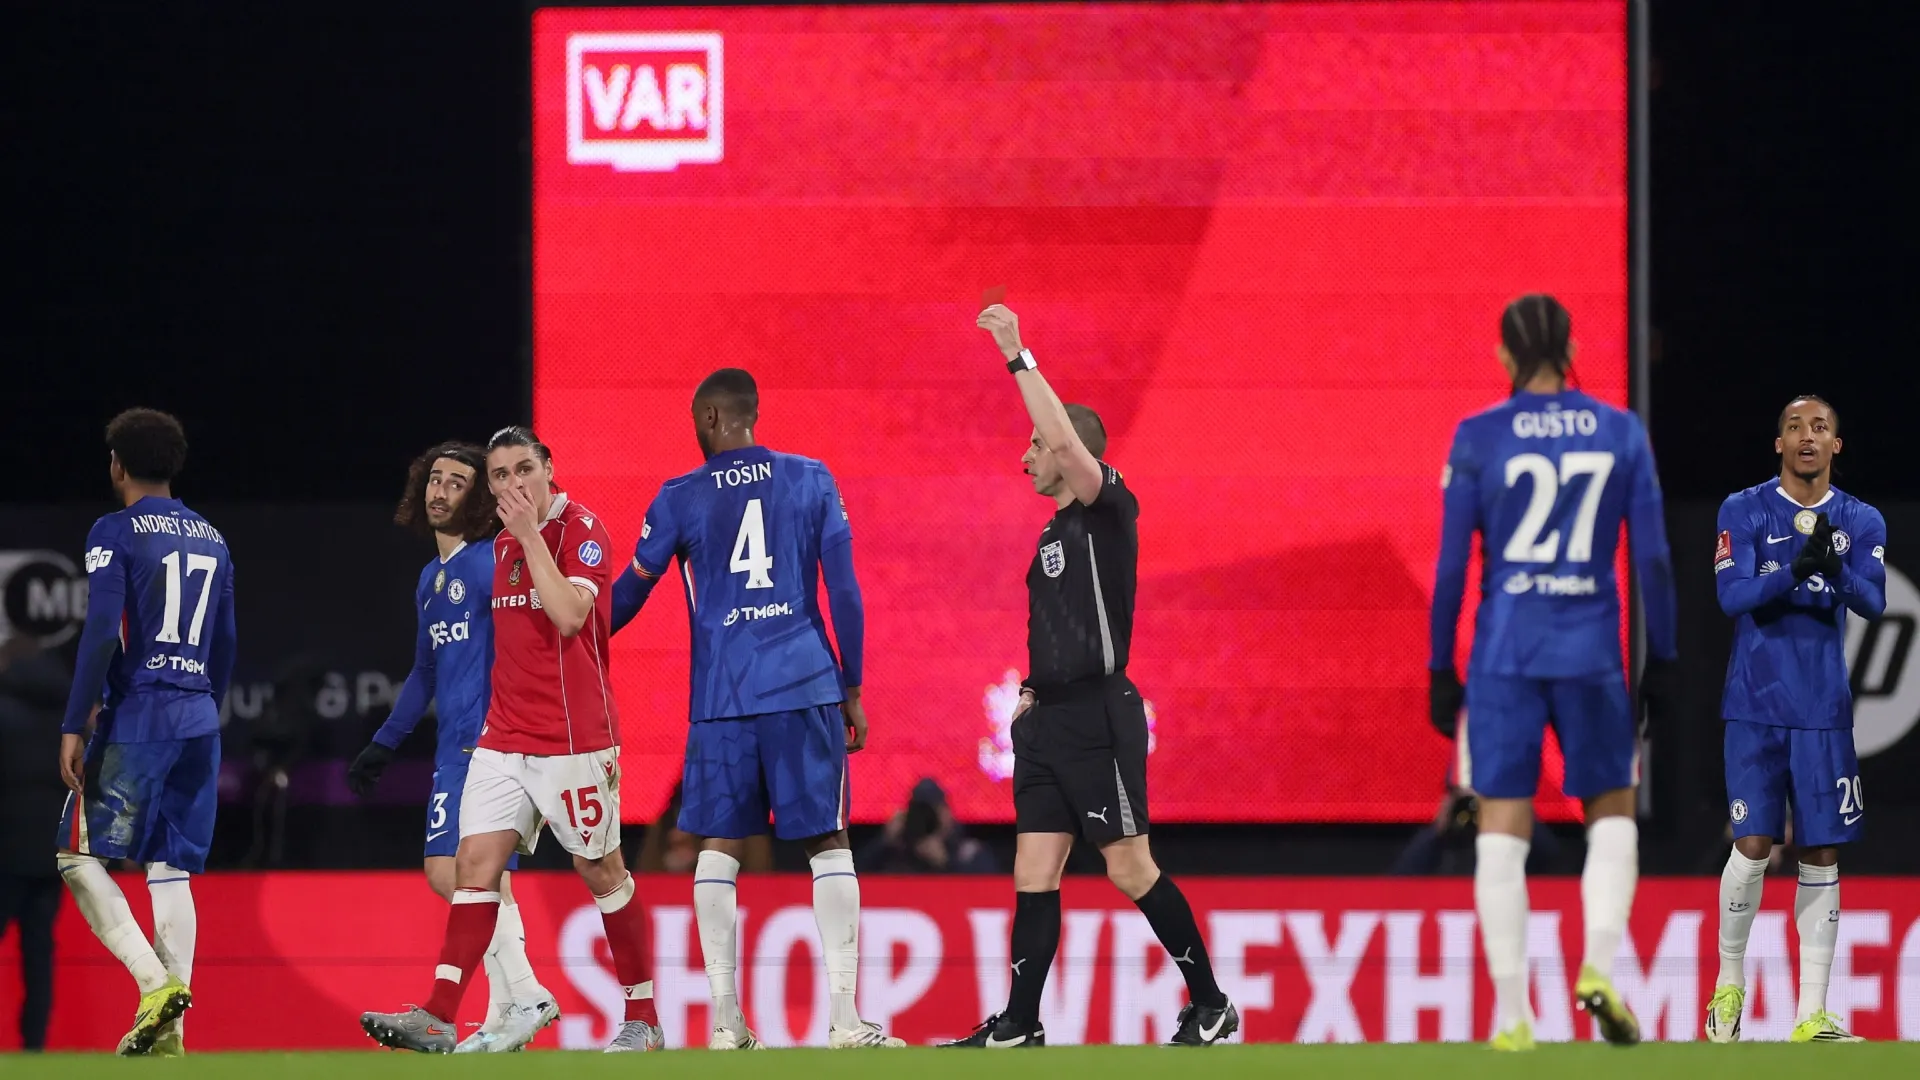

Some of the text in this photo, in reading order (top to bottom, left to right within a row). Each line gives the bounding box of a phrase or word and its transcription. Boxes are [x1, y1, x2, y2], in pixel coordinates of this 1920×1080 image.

[583, 64, 708, 131] VAR
[1512, 409, 1598, 438] GUSTO
[711, 462, 772, 489] TOSIN
[1503, 451, 1615, 563] 27
[131, 514, 224, 545] ANDREY SANTOS
[729, 498, 774, 589] 4
[580, 541, 601, 565] hp
[155, 551, 218, 647] 17
[491, 594, 527, 609] NITED
[431, 792, 448, 829] 3
[560, 785, 603, 828] 15
[1836, 775, 1864, 814] 20
